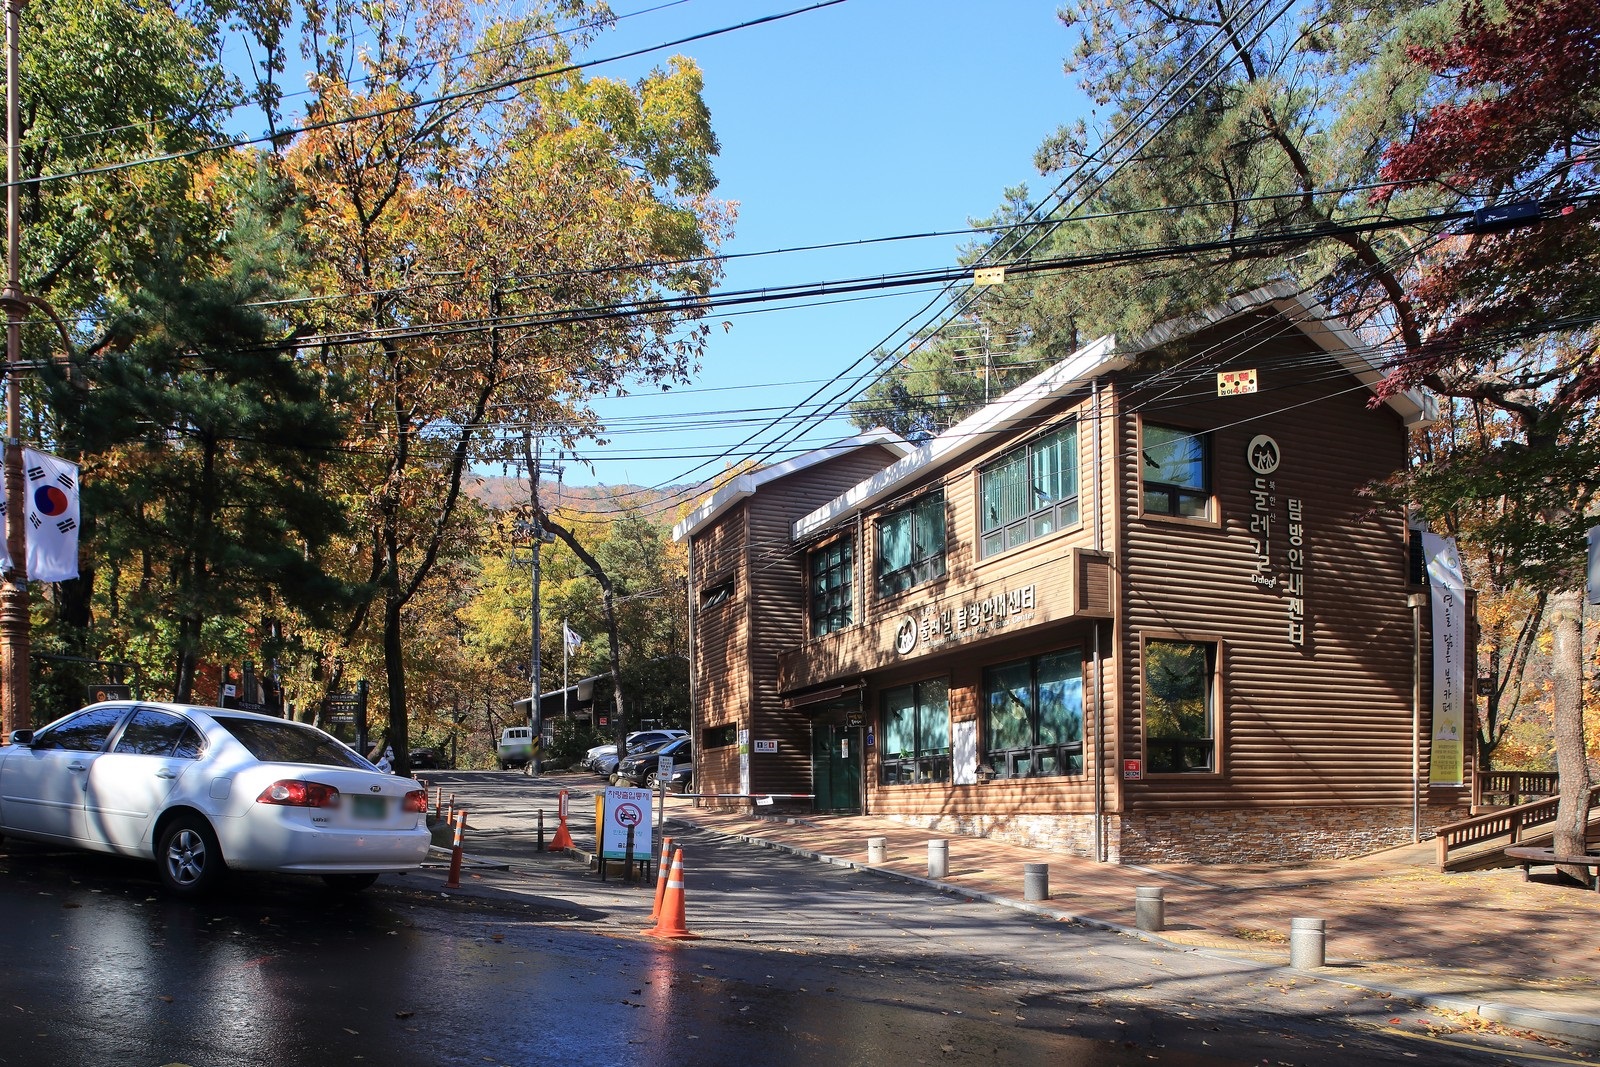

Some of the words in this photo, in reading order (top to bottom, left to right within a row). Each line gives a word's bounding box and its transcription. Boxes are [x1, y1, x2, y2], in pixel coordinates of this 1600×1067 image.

[1249, 478, 1272, 572] 둘레길
[1268, 481, 1276, 523] 북한산
[1287, 498, 1305, 646] 탐방안내센터
[919, 609, 953, 642] 둘레길
[957, 585, 1036, 631] 탐방안내센터
[1012, 612, 1035, 624] Center
[608, 790, 649, 801] 차량출입통제
